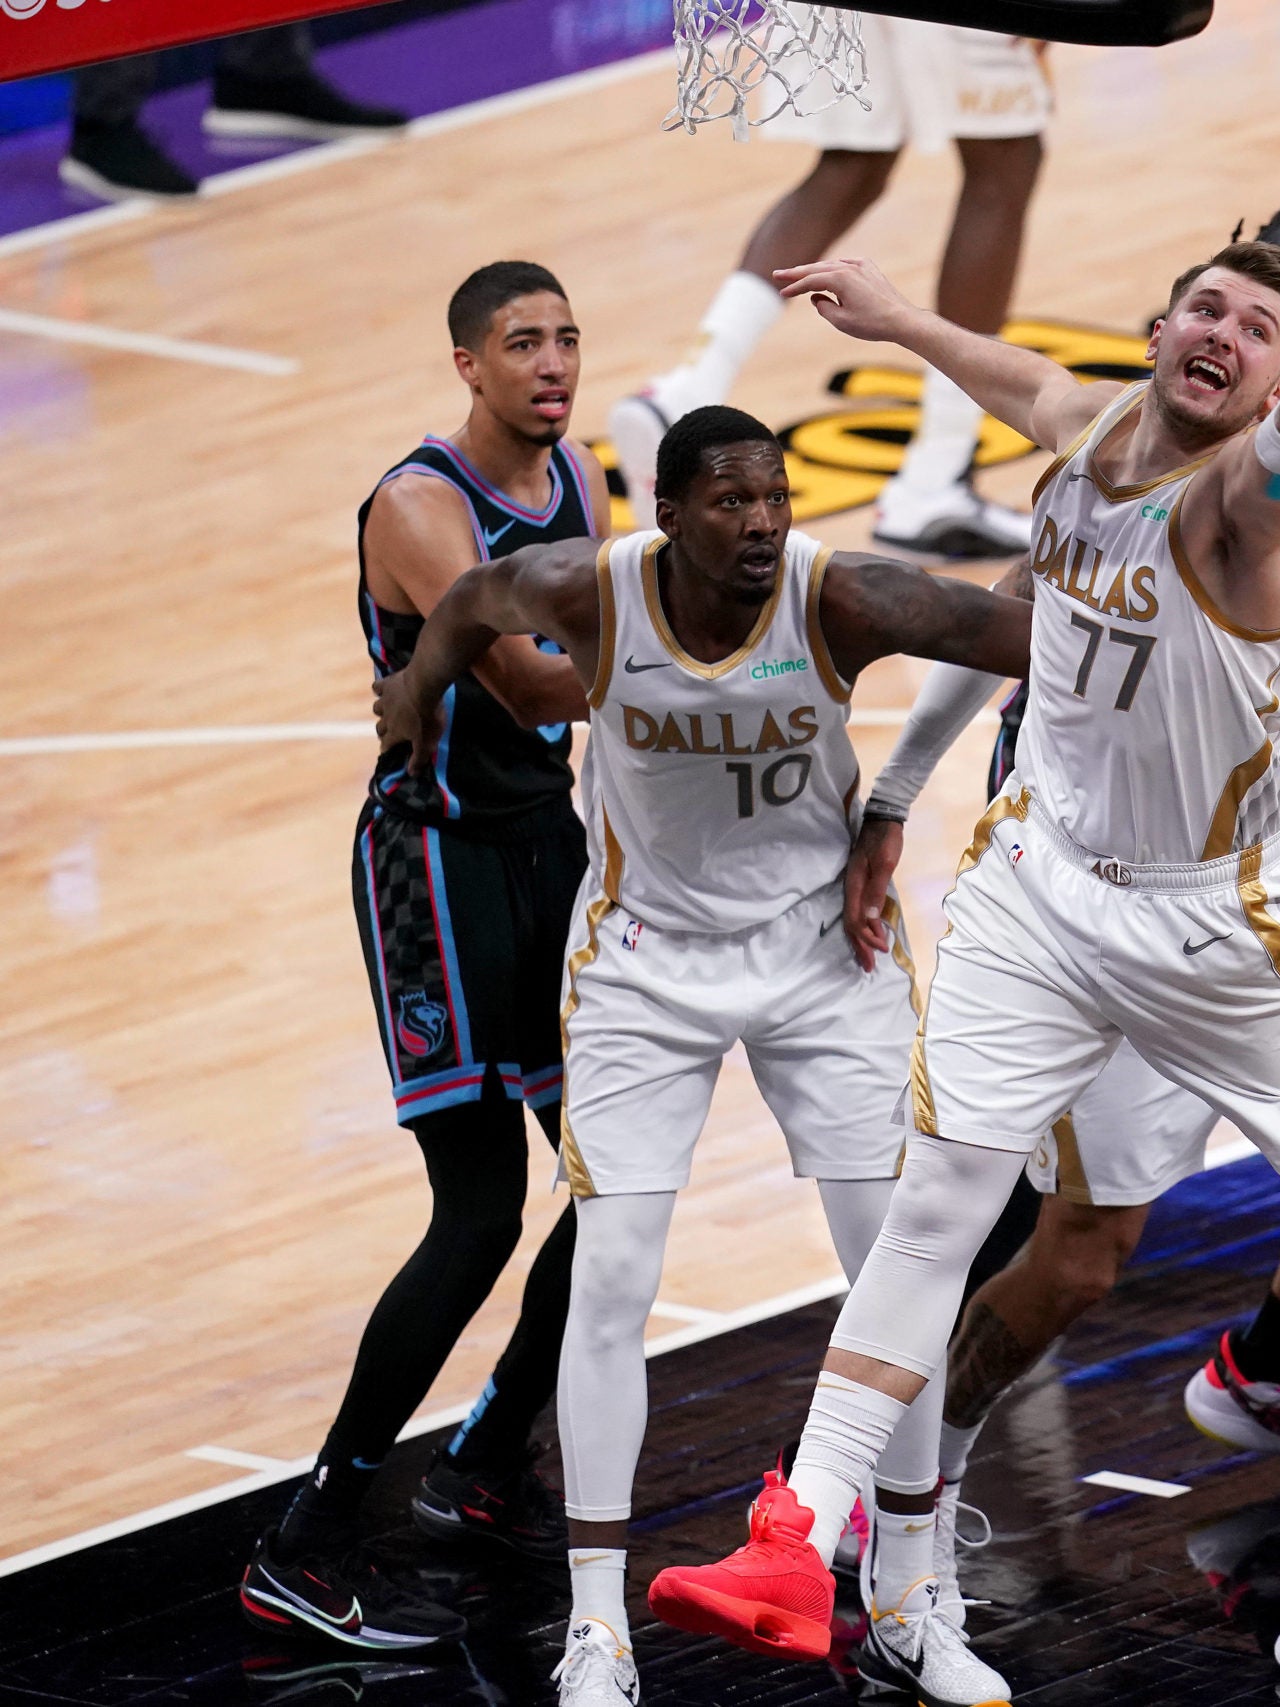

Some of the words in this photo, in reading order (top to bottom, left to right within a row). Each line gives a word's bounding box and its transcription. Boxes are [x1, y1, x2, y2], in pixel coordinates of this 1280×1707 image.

[1031, 514, 1159, 623] DALLAS
[751, 657, 809, 681] chime
[1071, 611, 1158, 713] 77
[619, 702, 820, 755] DALLAS
[726, 753, 812, 819] 10
